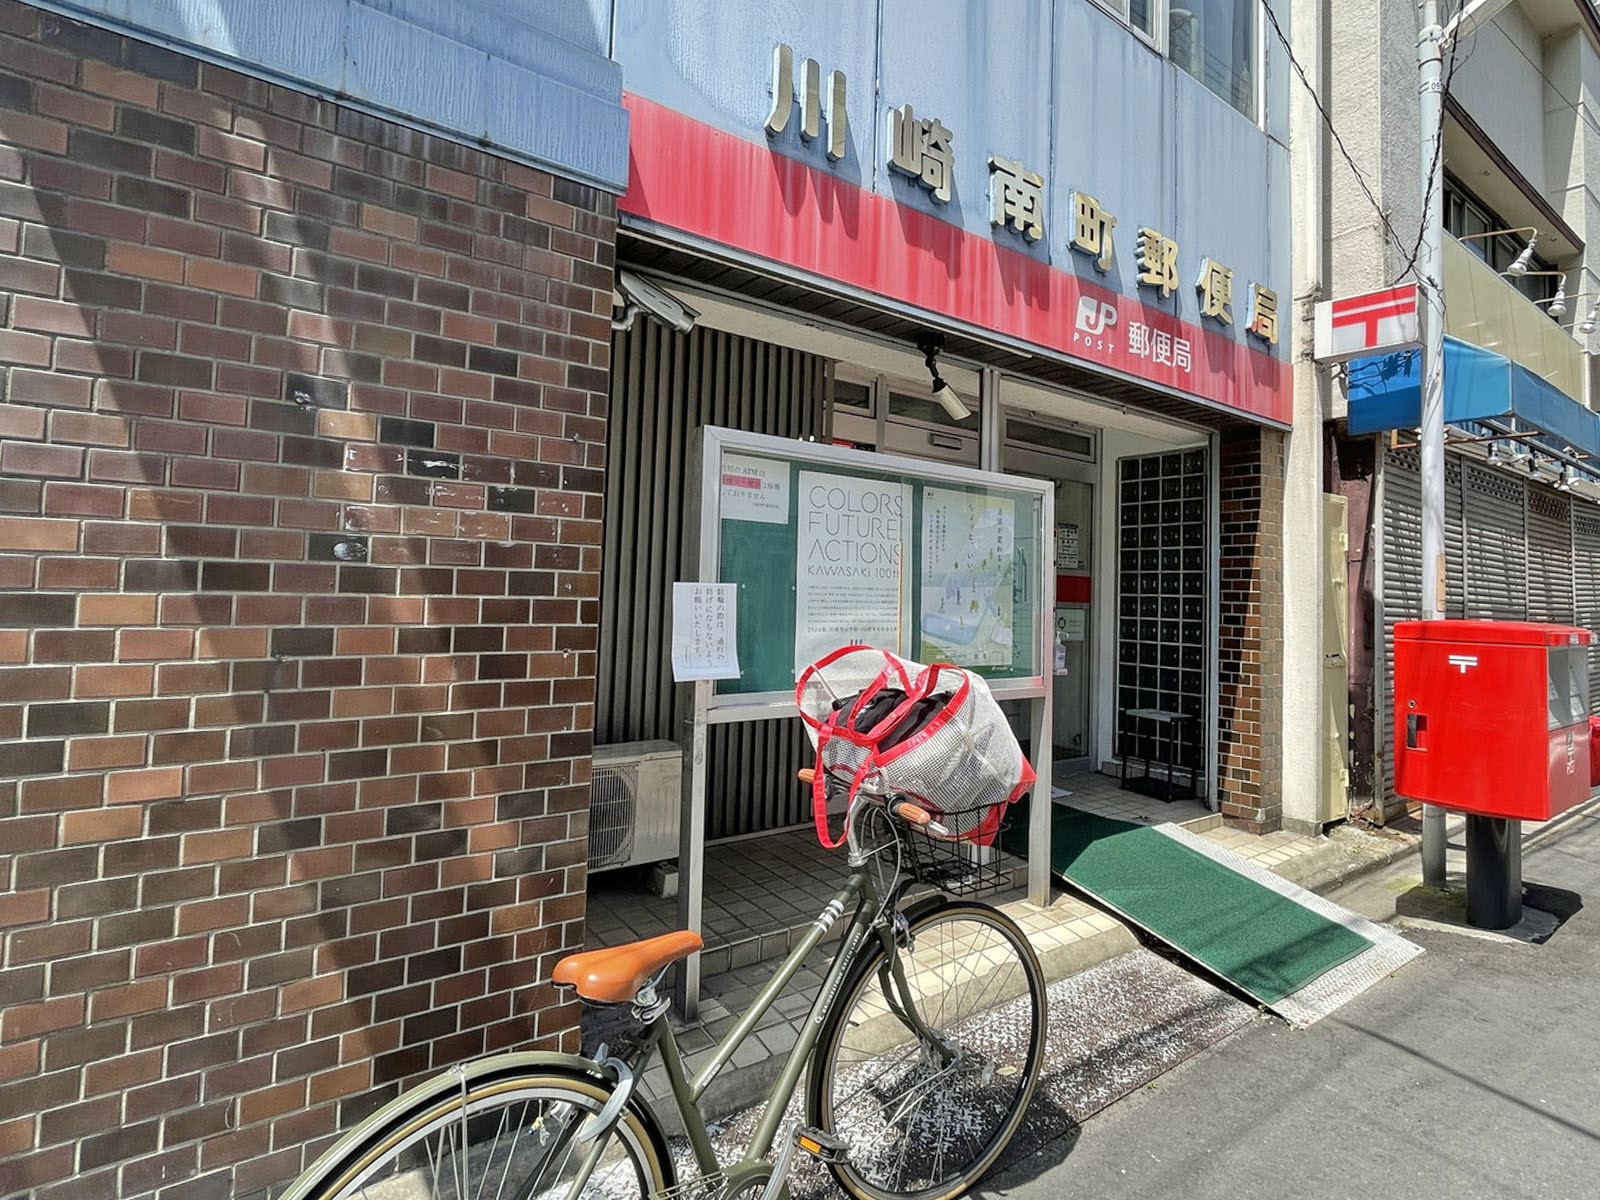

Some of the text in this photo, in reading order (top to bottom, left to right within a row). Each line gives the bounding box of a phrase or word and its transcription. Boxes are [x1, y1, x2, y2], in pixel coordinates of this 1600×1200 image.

[764, 43, 1279, 344] 川崎南町郵便局
[1075, 295, 1118, 335] JP
[1073, 332, 1114, 354] POST
[1128, 321, 1191, 373] 郵便局
[809, 485, 904, 518] COLORS
[808, 511, 898, 541] FUTURE
[808, 538, 900, 566] ACTIONS
[807, 564, 871, 578] KAWASAKI
